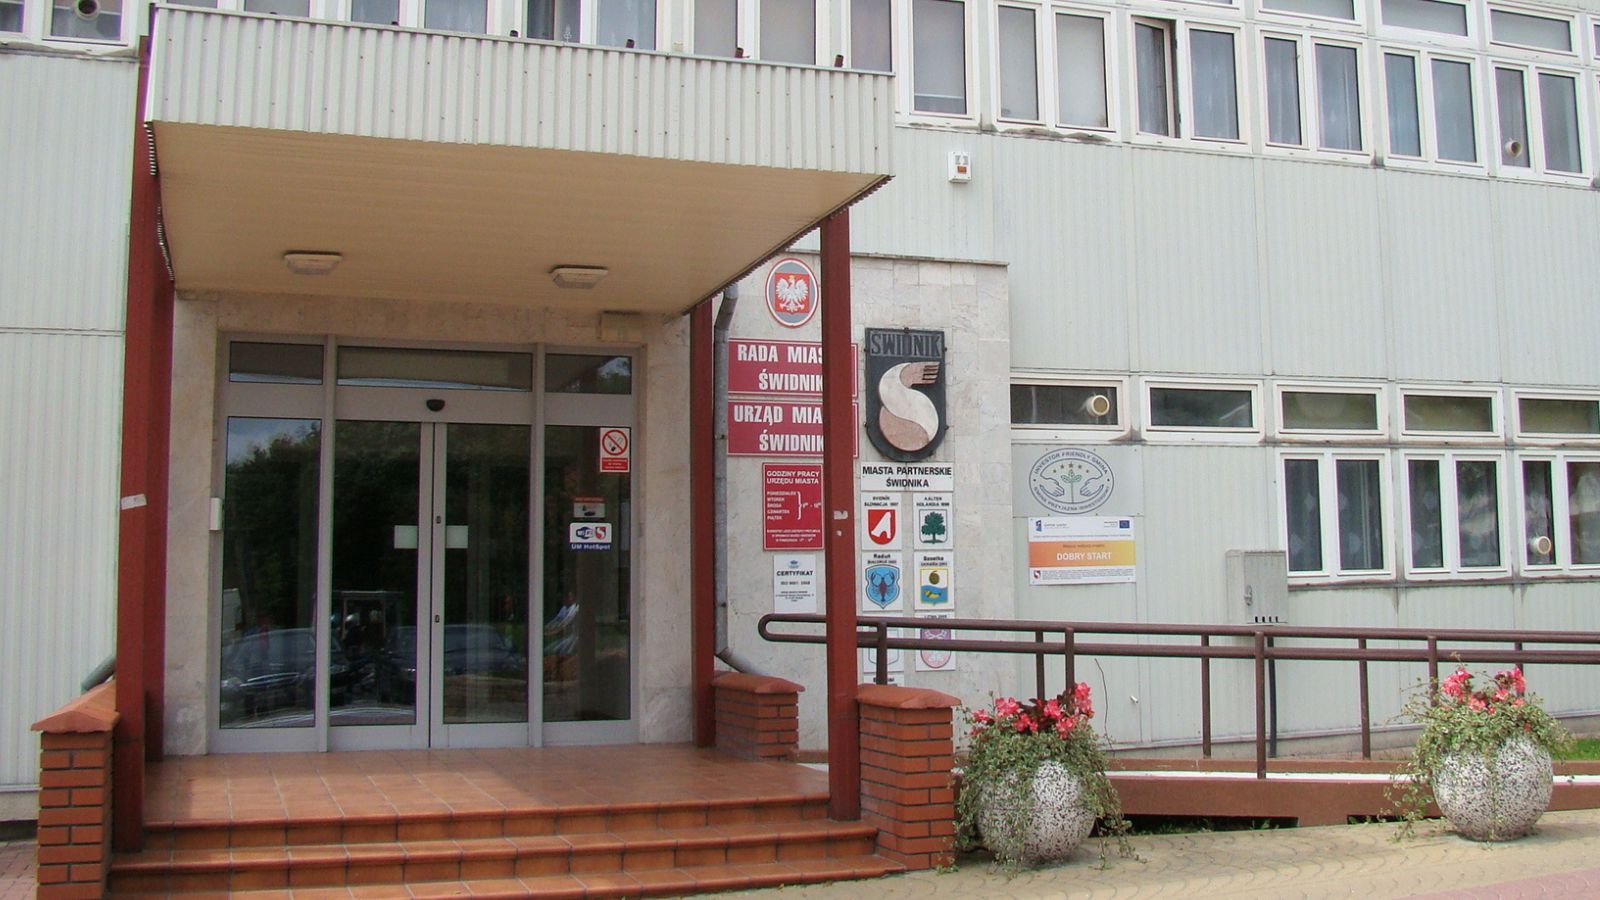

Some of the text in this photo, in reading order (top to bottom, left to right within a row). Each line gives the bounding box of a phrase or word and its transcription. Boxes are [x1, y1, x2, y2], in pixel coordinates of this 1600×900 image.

[737, 344, 779, 362] RADA
[734, 405, 783, 426] URZĄD
[1034, 452, 1060, 474] INVESTOR
[1062, 451, 1090, 459] FRIENDLY
[862, 466, 952, 475] MIASTA PARTNERSKIE
[886, 477, 929, 487] ŚWIDNIKA
[1056, 551, 1112, 560] DOBRY START
